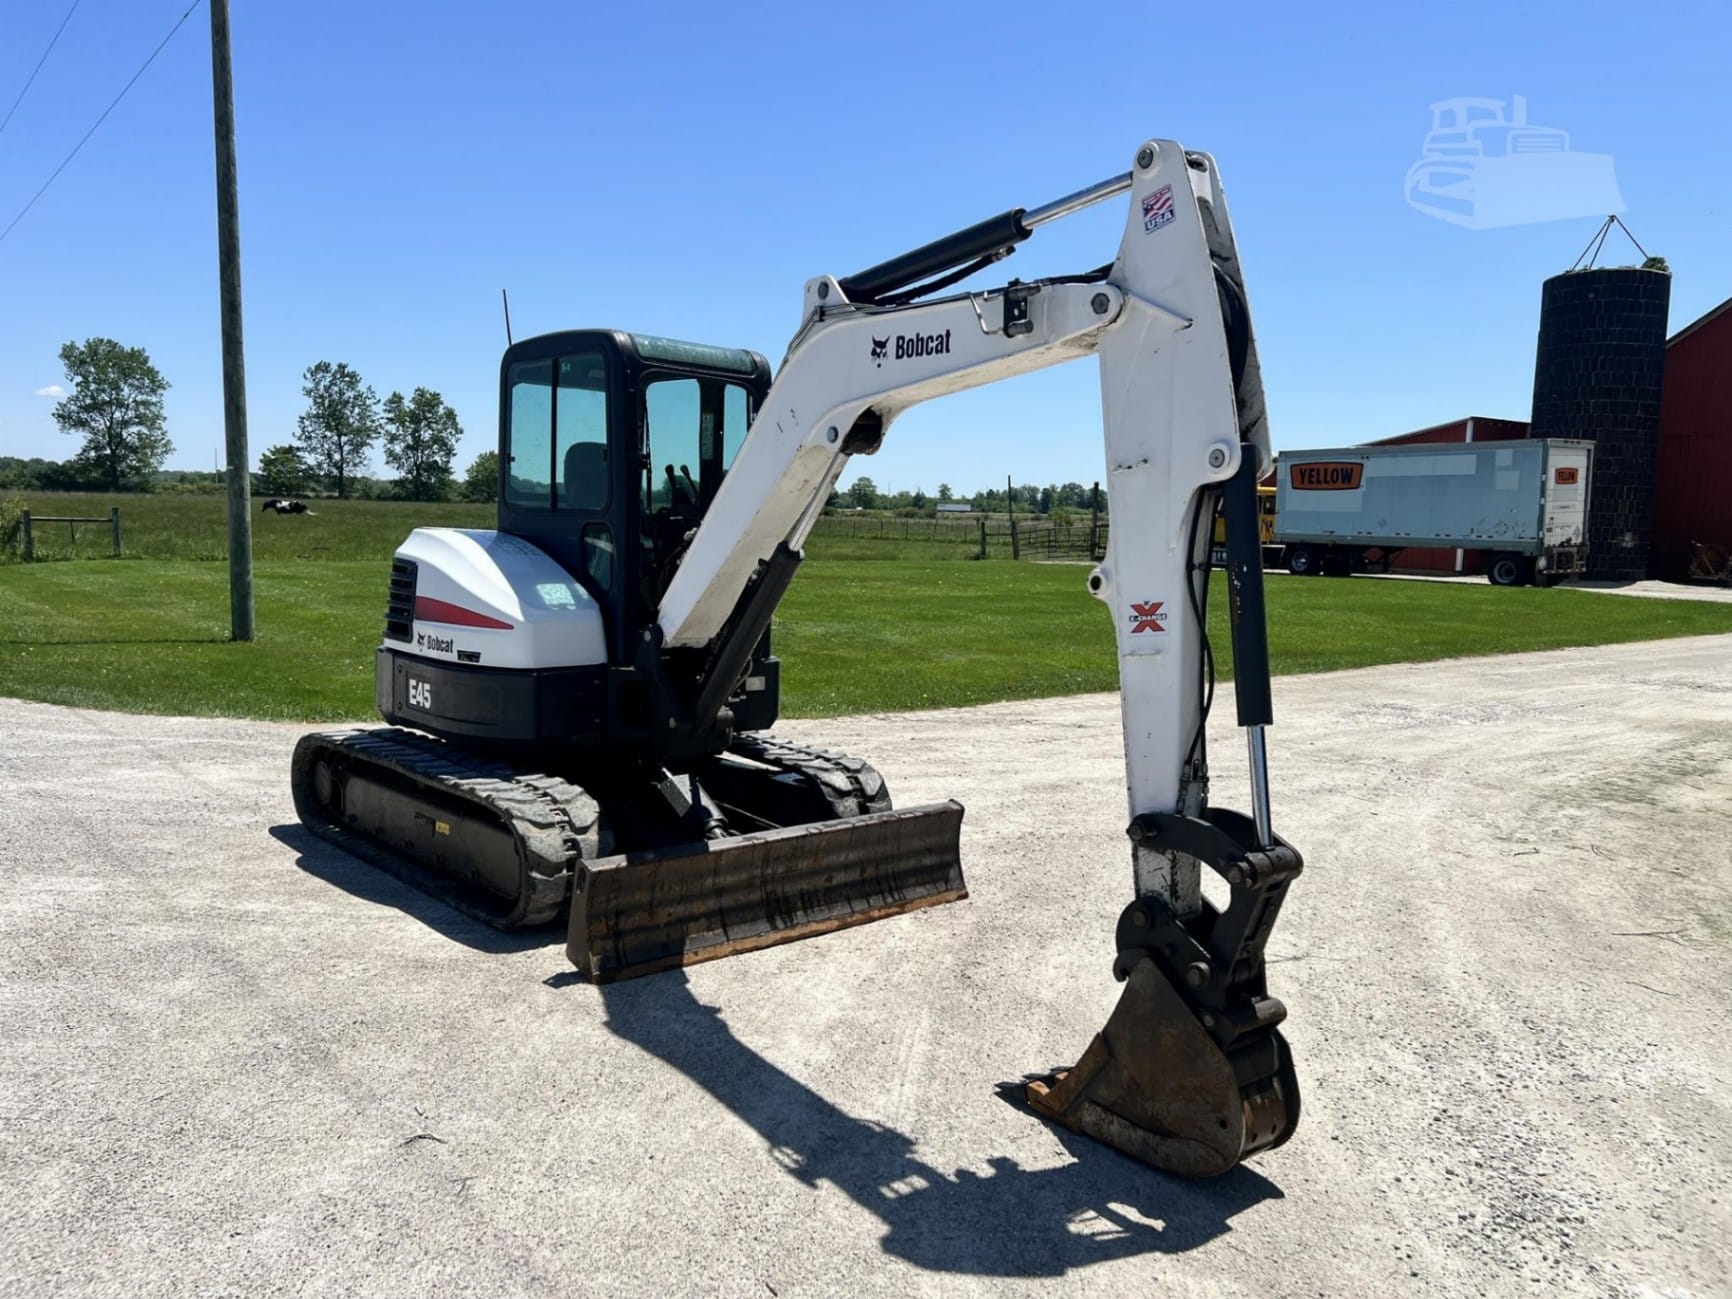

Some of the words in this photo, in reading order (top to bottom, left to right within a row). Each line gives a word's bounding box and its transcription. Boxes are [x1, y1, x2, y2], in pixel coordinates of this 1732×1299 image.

[1146, 210, 1173, 229] USA
[895, 329, 951, 360] Bobcat
[1299, 467, 1354, 484] YELLOW
[427, 635, 454, 654] Bobcat
[408, 678, 432, 709] E45
